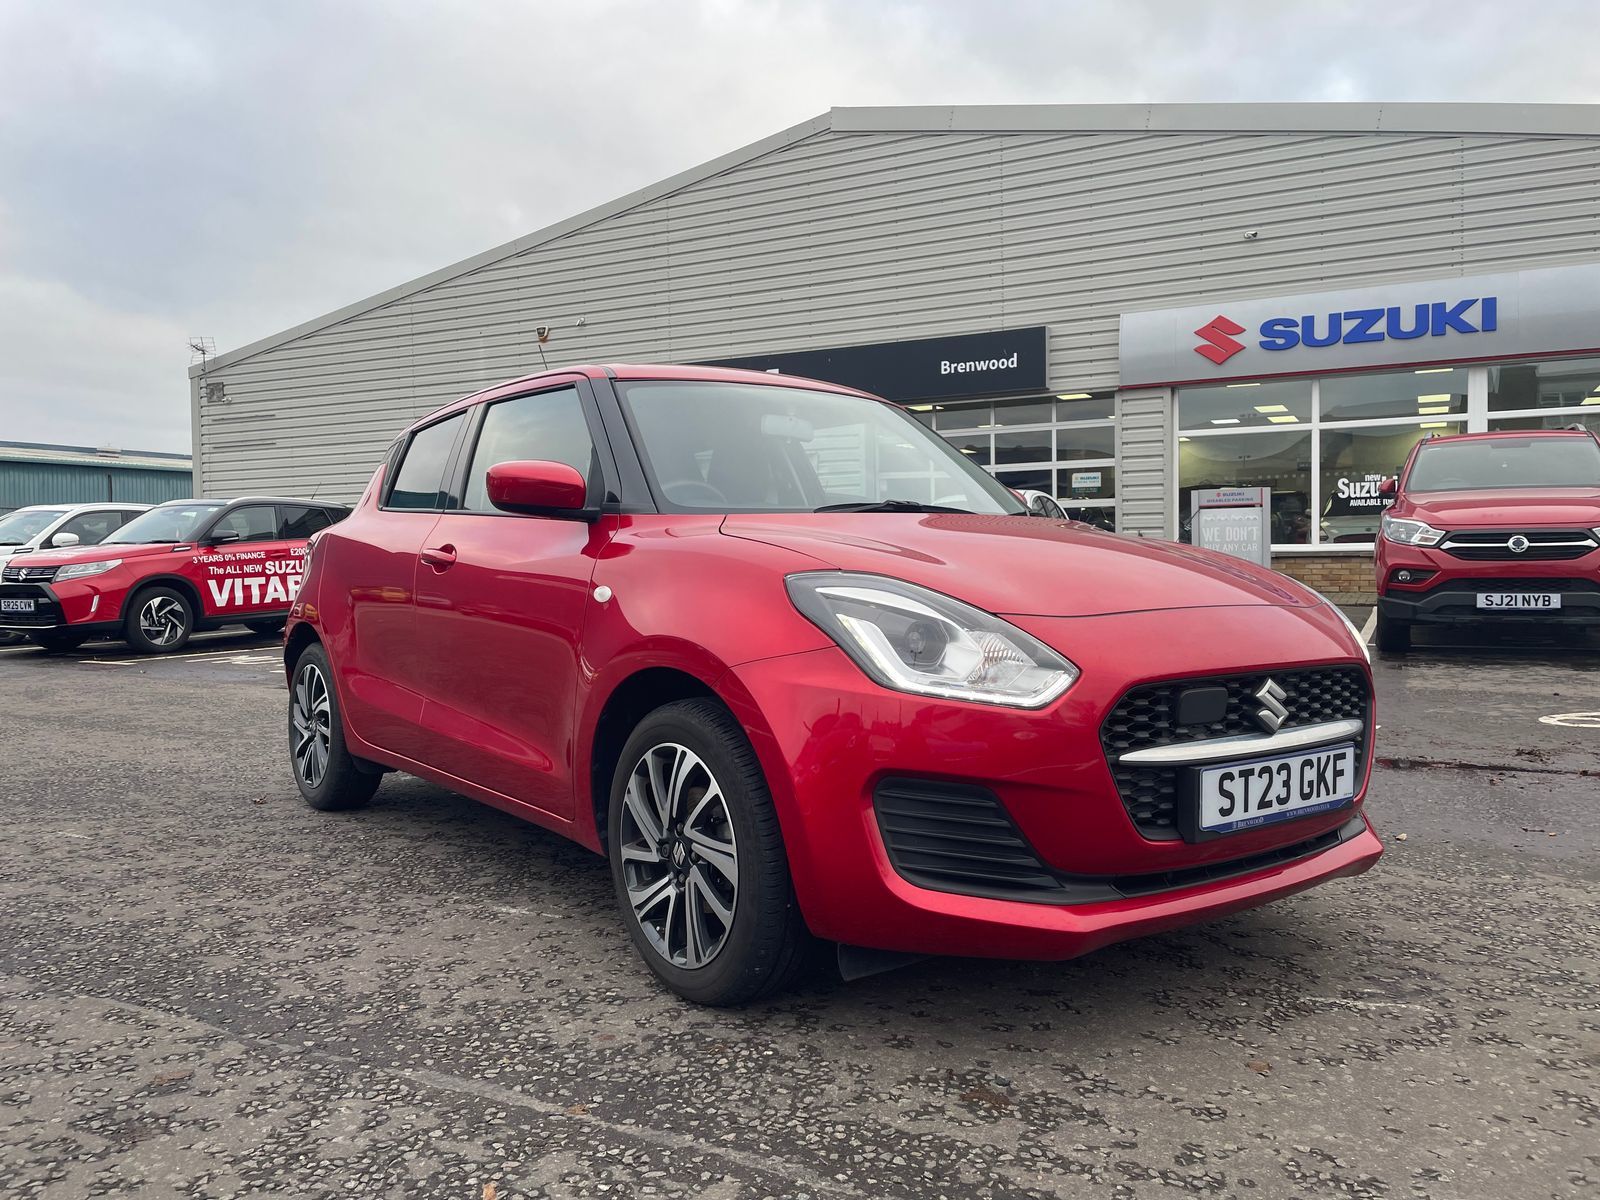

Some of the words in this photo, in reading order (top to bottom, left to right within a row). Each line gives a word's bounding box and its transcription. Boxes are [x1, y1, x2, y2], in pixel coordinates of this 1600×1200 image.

[1259, 297, 1497, 350] SUZUKI
[941, 352, 1017, 374] Brenwood
[1337, 475, 1398, 498] Suzui
[1350, 498, 1381, 506] AVAILABLE
[1202, 527, 1221, 541] WE
[1226, 526, 1258, 541] DON'T
[1222, 543, 1239, 552] ANY
[1241, 543, 1258, 552] CAR
[193, 556, 198, 564] 3
[199, 554, 224, 563] YEARS
[225, 553, 235, 561] 0%
[236, 551, 266, 560] FINANCE
[209, 566, 224, 575] The
[225, 565, 242, 574] ALL
[243, 564, 262, 573] NEW
[1485, 595, 1518, 606] SJ21
[1522, 595, 1551, 606] NYB
[1218, 762, 1291, 818] ST23
[1300, 752, 1347, 801] GKF
